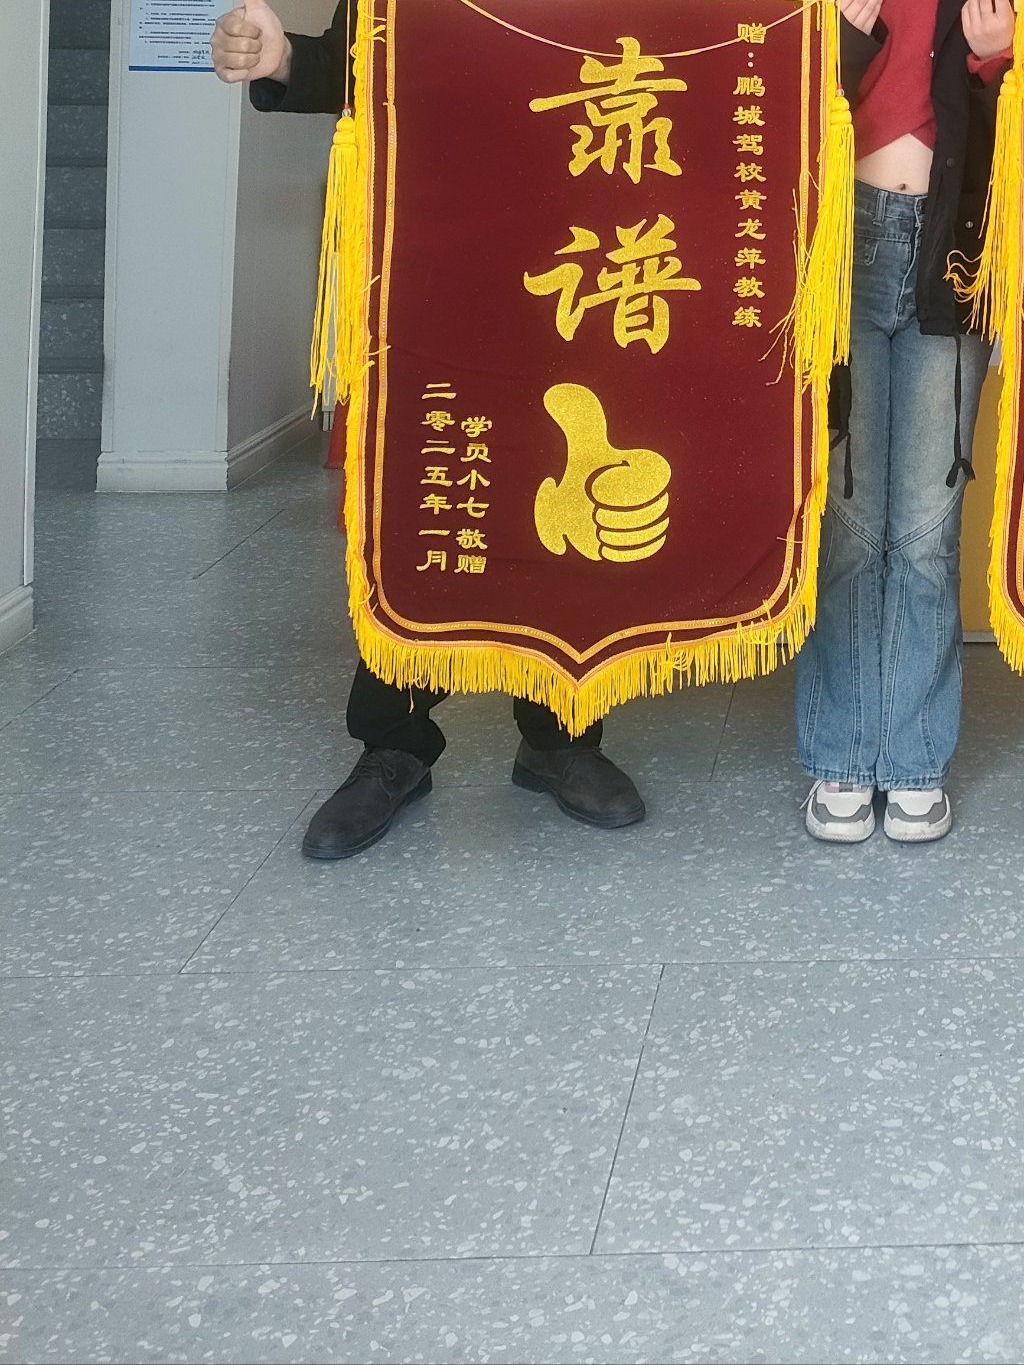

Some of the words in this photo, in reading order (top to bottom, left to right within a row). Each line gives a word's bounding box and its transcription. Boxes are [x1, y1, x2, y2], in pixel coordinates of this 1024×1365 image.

[523, 36, 702, 355] 靠谱
[416, 382, 457, 572] 二零二五年一月
